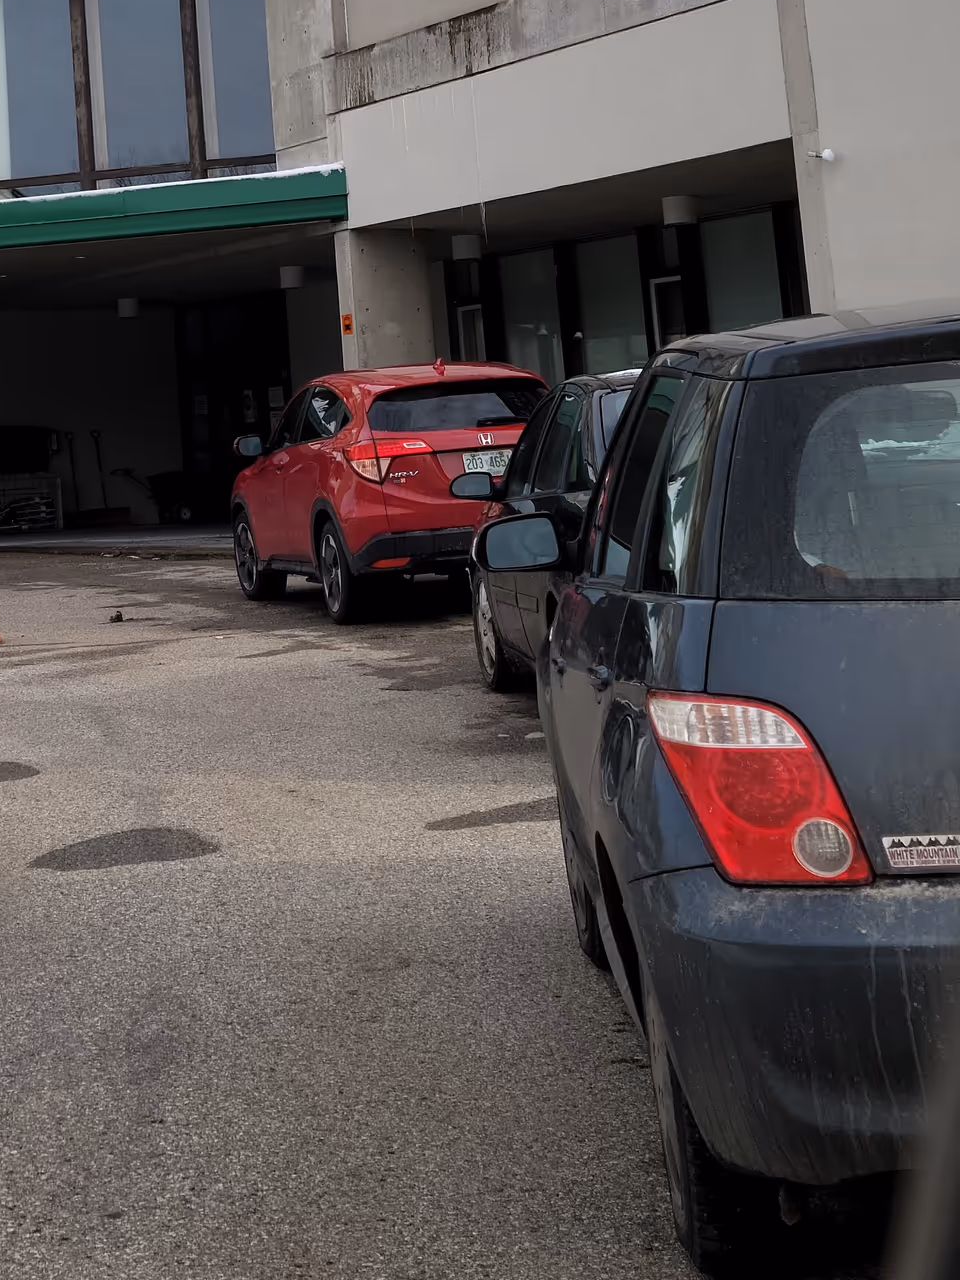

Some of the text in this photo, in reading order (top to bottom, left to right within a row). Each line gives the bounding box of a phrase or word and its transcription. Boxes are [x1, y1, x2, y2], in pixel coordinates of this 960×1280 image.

[466, 457, 484, 470] 203
[389, 470, 419, 479] HR-V
[888, 847, 959, 861] WHITE MOUNTAIN
